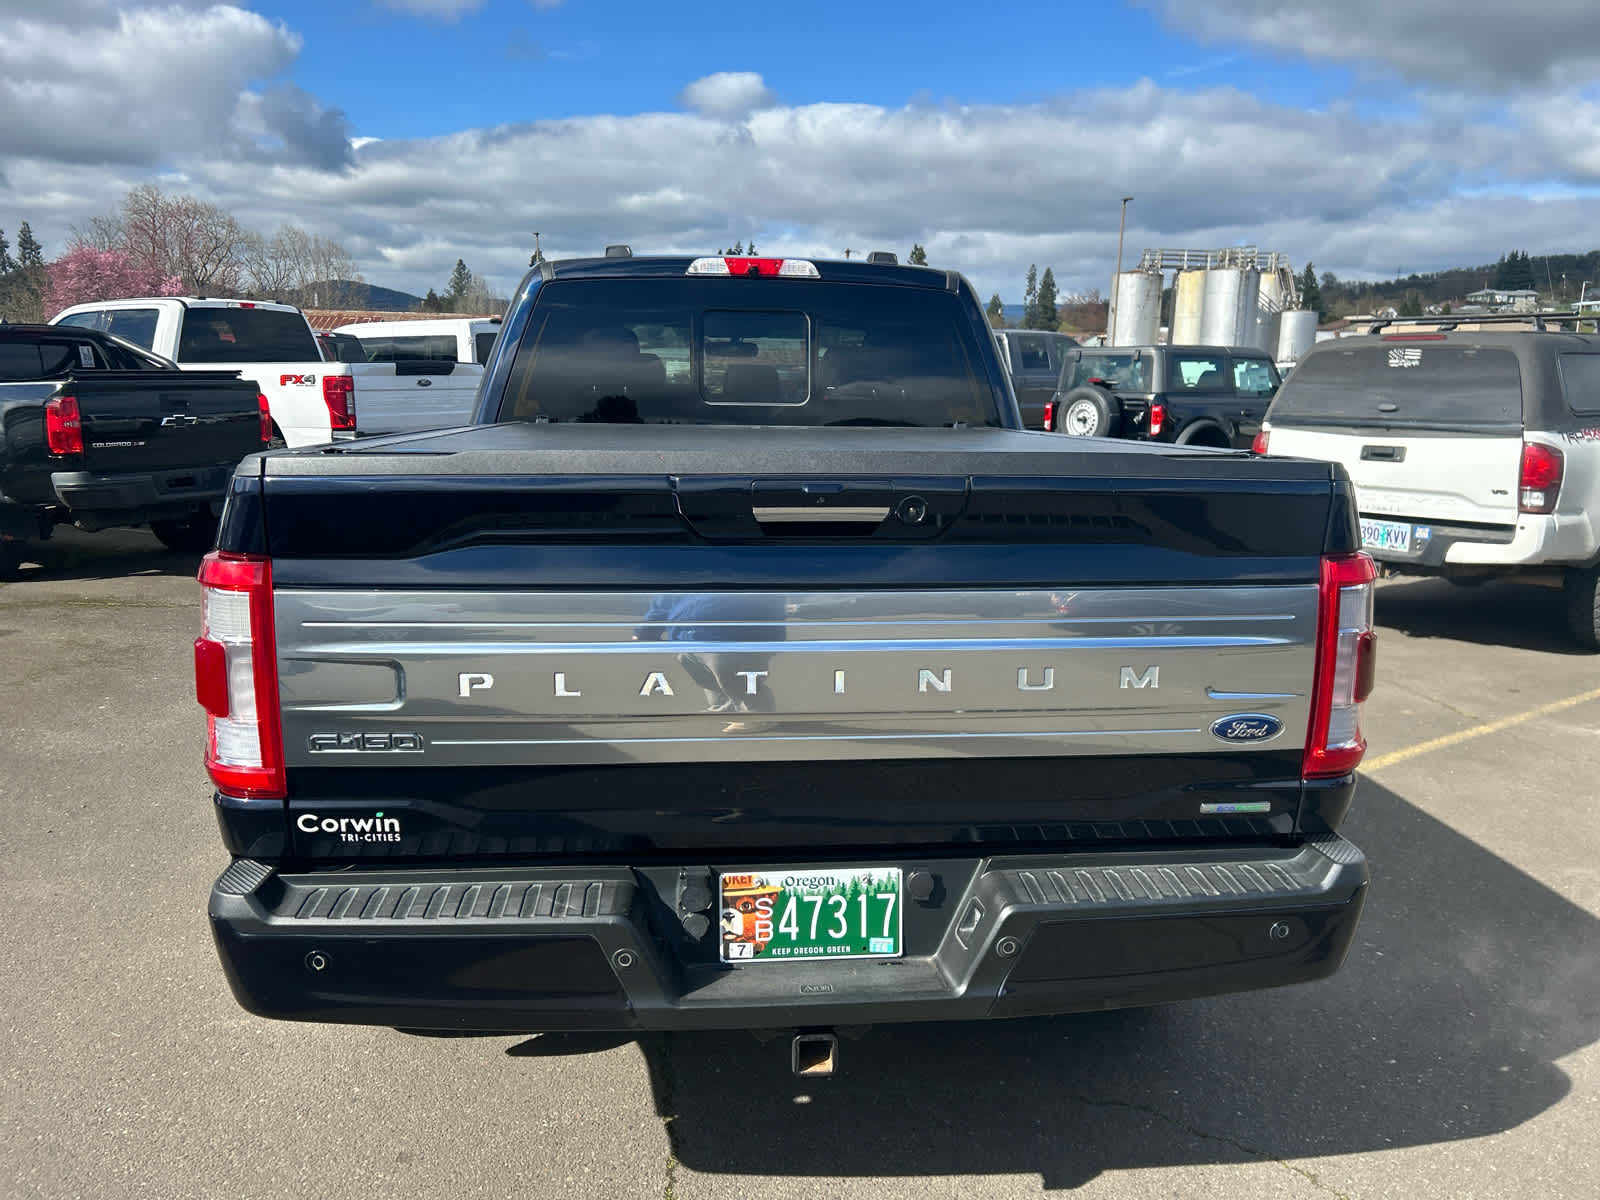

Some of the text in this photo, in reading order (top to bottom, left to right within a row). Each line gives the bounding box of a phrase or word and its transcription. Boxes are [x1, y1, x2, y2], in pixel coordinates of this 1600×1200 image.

[280, 374, 316, 386] FX4
[1361, 526, 1380, 541] 390
[1386, 528, 1407, 545] KVV
[458, 665, 1160, 697] PLATINUM
[1226, 720, 1269, 738] Ford
[307, 733, 425, 754] F-150
[297, 811, 401, 833] Corwin
[340, 833, 401, 842] TRI-CITIES
[785, 875, 835, 889] Oregon
[778, 893, 896, 941] 47317
[737, 944, 747, 957] 7
[794, 946, 824, 954] OREGON
[827, 945, 851, 953] GREEN
